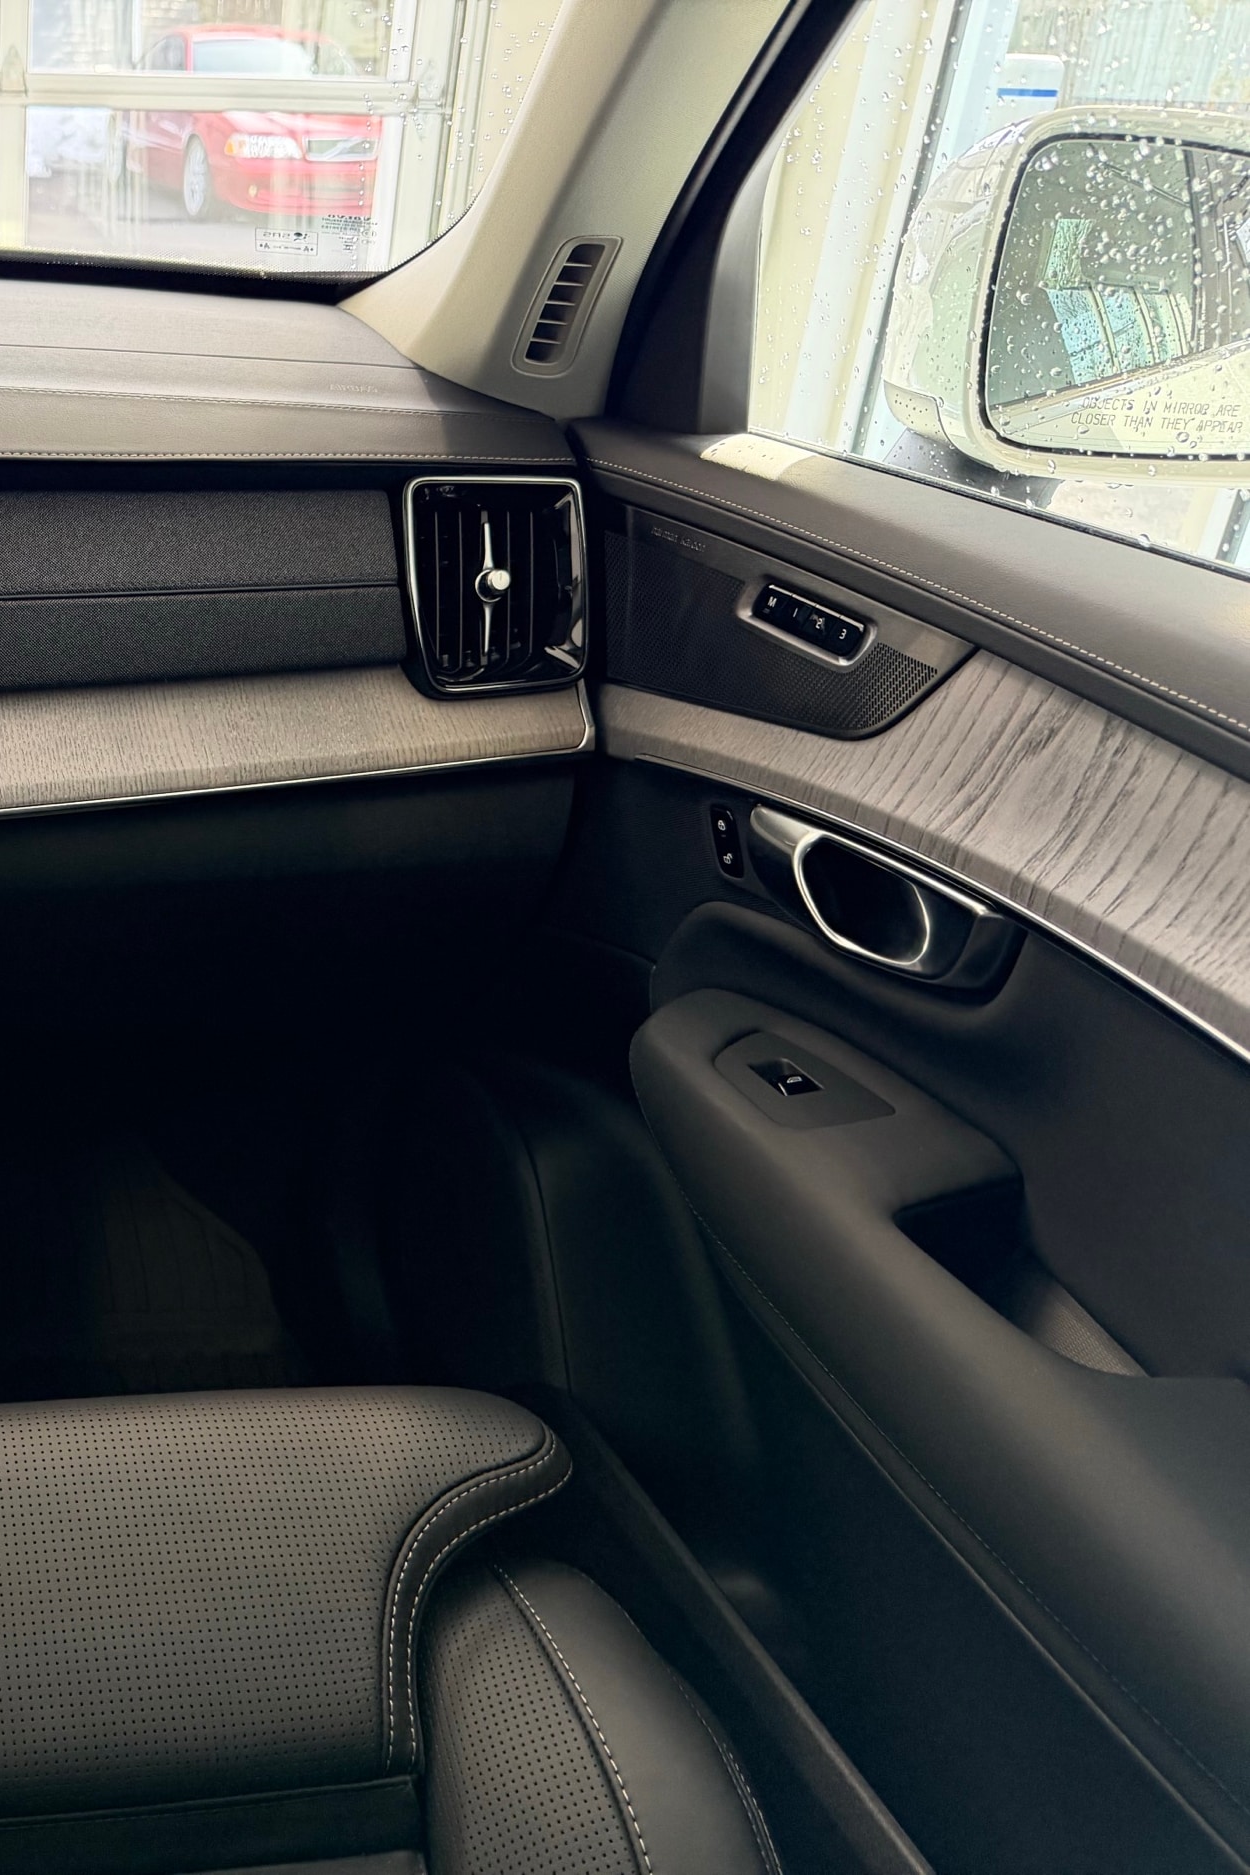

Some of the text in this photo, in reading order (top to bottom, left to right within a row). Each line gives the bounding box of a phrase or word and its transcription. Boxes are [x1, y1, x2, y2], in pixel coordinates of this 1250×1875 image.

[1081, 397, 1242, 418] OBJECTS IN MIRROR ARE
[1071, 412, 1116, 426] CLOSER
[1124, 415, 1153, 429] THAN
[1161, 417, 1192, 431] THEY
[815, 617, 824, 630] 2
[838, 628, 848, 640] 3
